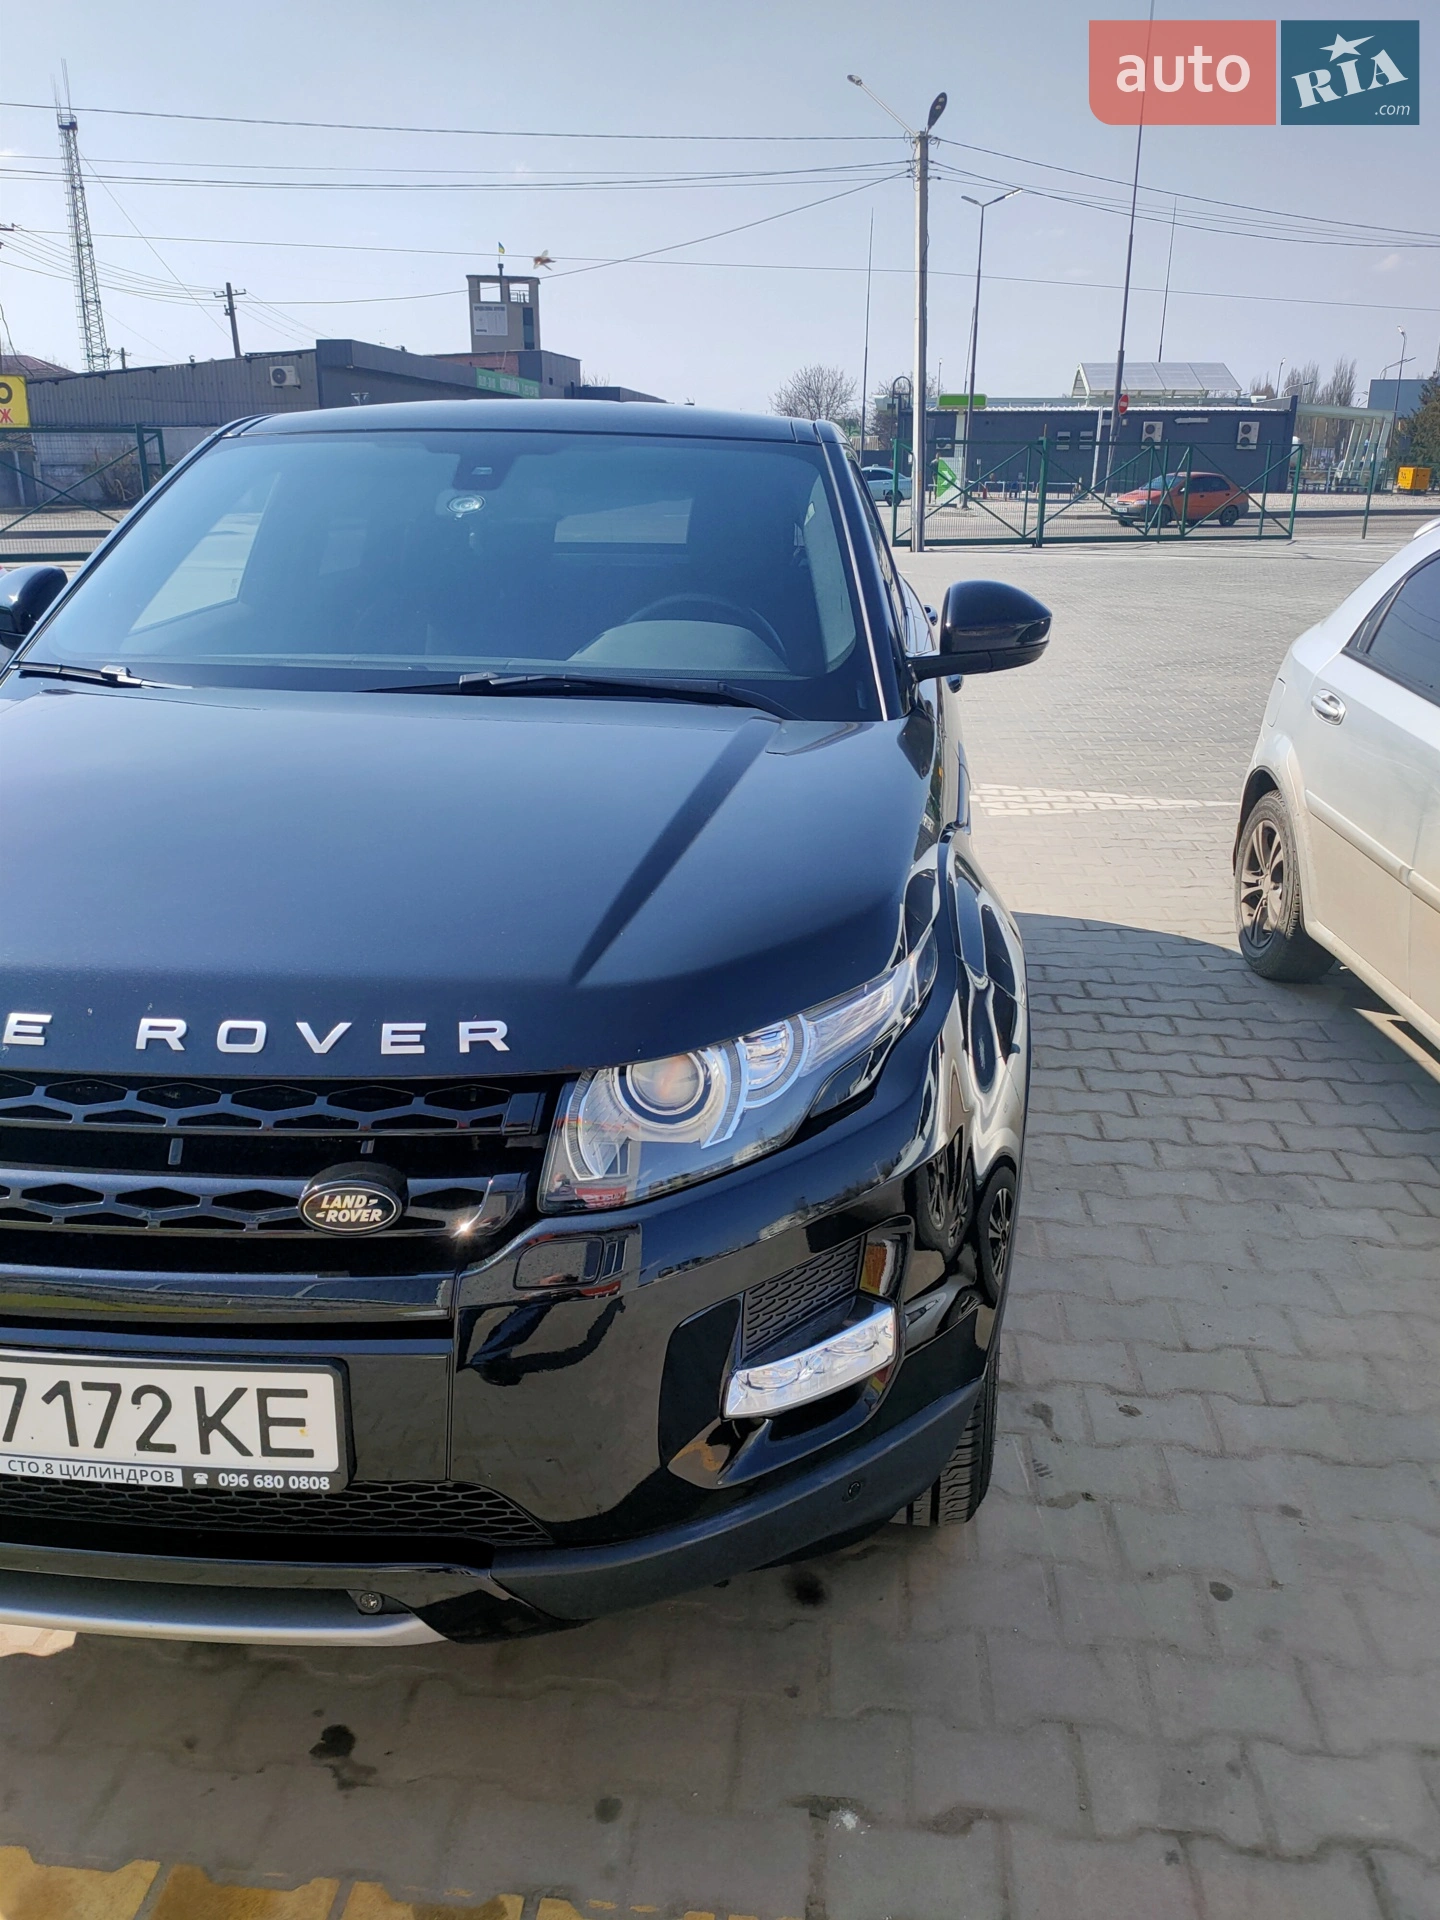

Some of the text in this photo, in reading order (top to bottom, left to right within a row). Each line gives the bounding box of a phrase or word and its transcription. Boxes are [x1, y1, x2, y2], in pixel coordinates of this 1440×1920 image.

[135, 1018, 510, 1054] ROVER
[320, 1195, 367, 1209] LAND
[325, 1208, 383, 1223] ROVER
[194, 1386, 315, 1459] KE
[59, 1464, 175, 1484] ЦИЛИНДРОВ
[218, 1473, 249, 1487] 096
[253, 1475, 284, 1489] 680
[288, 1476, 330, 1490] 0808
